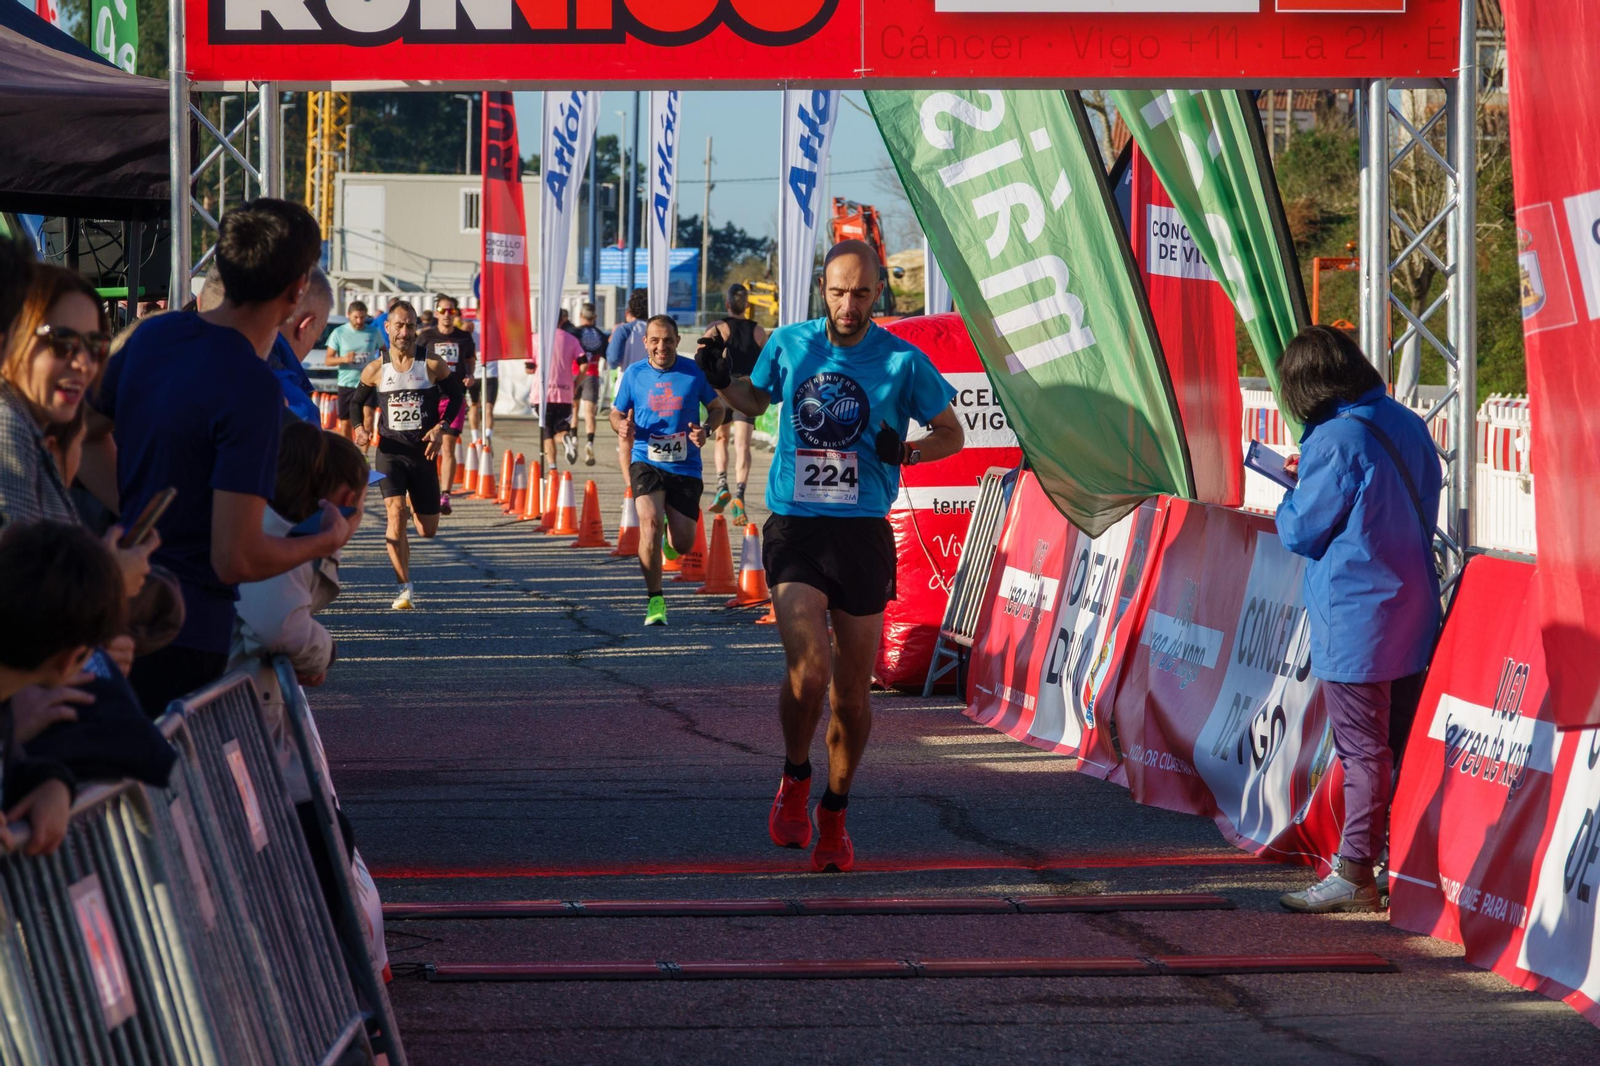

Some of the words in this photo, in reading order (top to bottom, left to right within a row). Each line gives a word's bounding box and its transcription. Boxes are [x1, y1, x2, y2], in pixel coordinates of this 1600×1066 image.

[880, 24, 1030, 60] Cáncer
[1069, 25, 1161, 69] Vigo
[1181, 26, 1239, 60] +11
[1281, 26, 1326, 60] La
[1344, 26, 1385, 60] 21
[1159, 244, 1178, 261] DE
[441, 348, 457, 357] 241
[813, 374, 857, 391] RUNNERS
[393, 409, 420, 422] 226
[804, 431, 819, 446] AND
[652, 441, 682, 454] 244
[804, 463, 858, 488] 224
[1480, 892, 1508, 921] PARA
